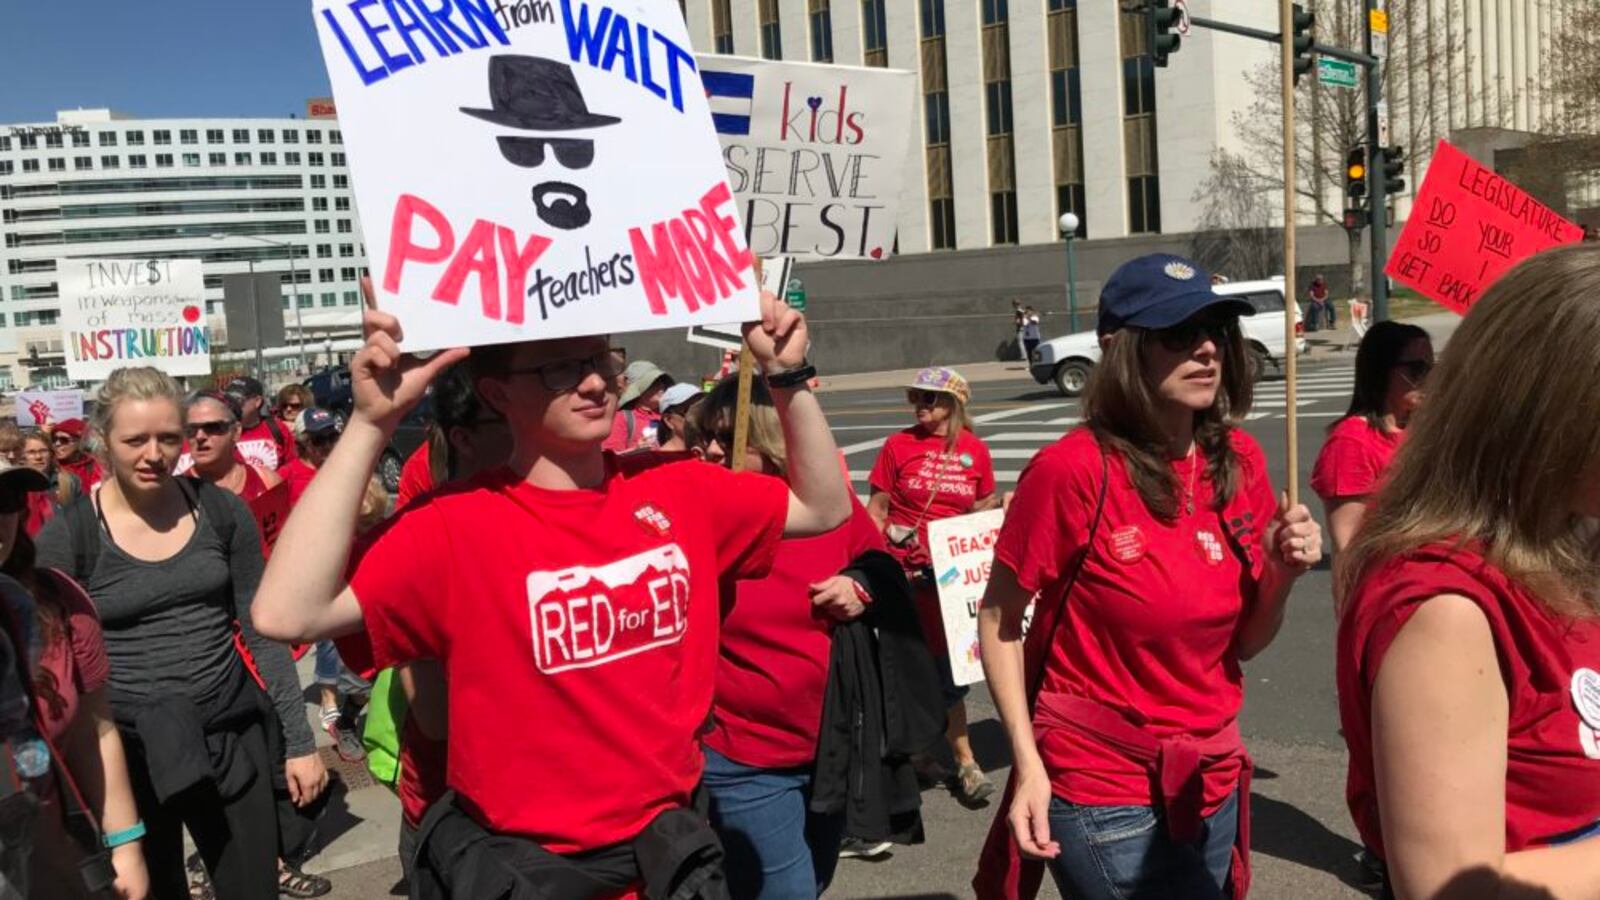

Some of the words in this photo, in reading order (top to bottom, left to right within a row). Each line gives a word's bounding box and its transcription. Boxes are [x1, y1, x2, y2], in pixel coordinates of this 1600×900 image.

[321, 0, 510, 87] LEARN
[494, 0, 555, 31] from
[559, 0, 697, 114] WALT
[780, 81, 865, 145] kids
[1429, 196, 1457, 226] DO
[1478, 219, 1515, 256] YOUR
[1458, 159, 1567, 243] LEGISLATURE
[383, 193, 554, 325] PAY
[528, 246, 635, 320] teachers
[629, 181, 753, 316] MORE
[1417, 230, 1442, 255] SO
[1397, 252, 1433, 284] GET
[1437, 273, 1479, 307] BACK
[70, 325, 210, 362] INSTRUCTION
[87, 310, 107, 327] of
[540, 594, 615, 665] RED
[618, 608, 649, 632] for
[648, 572, 690, 638] ED
